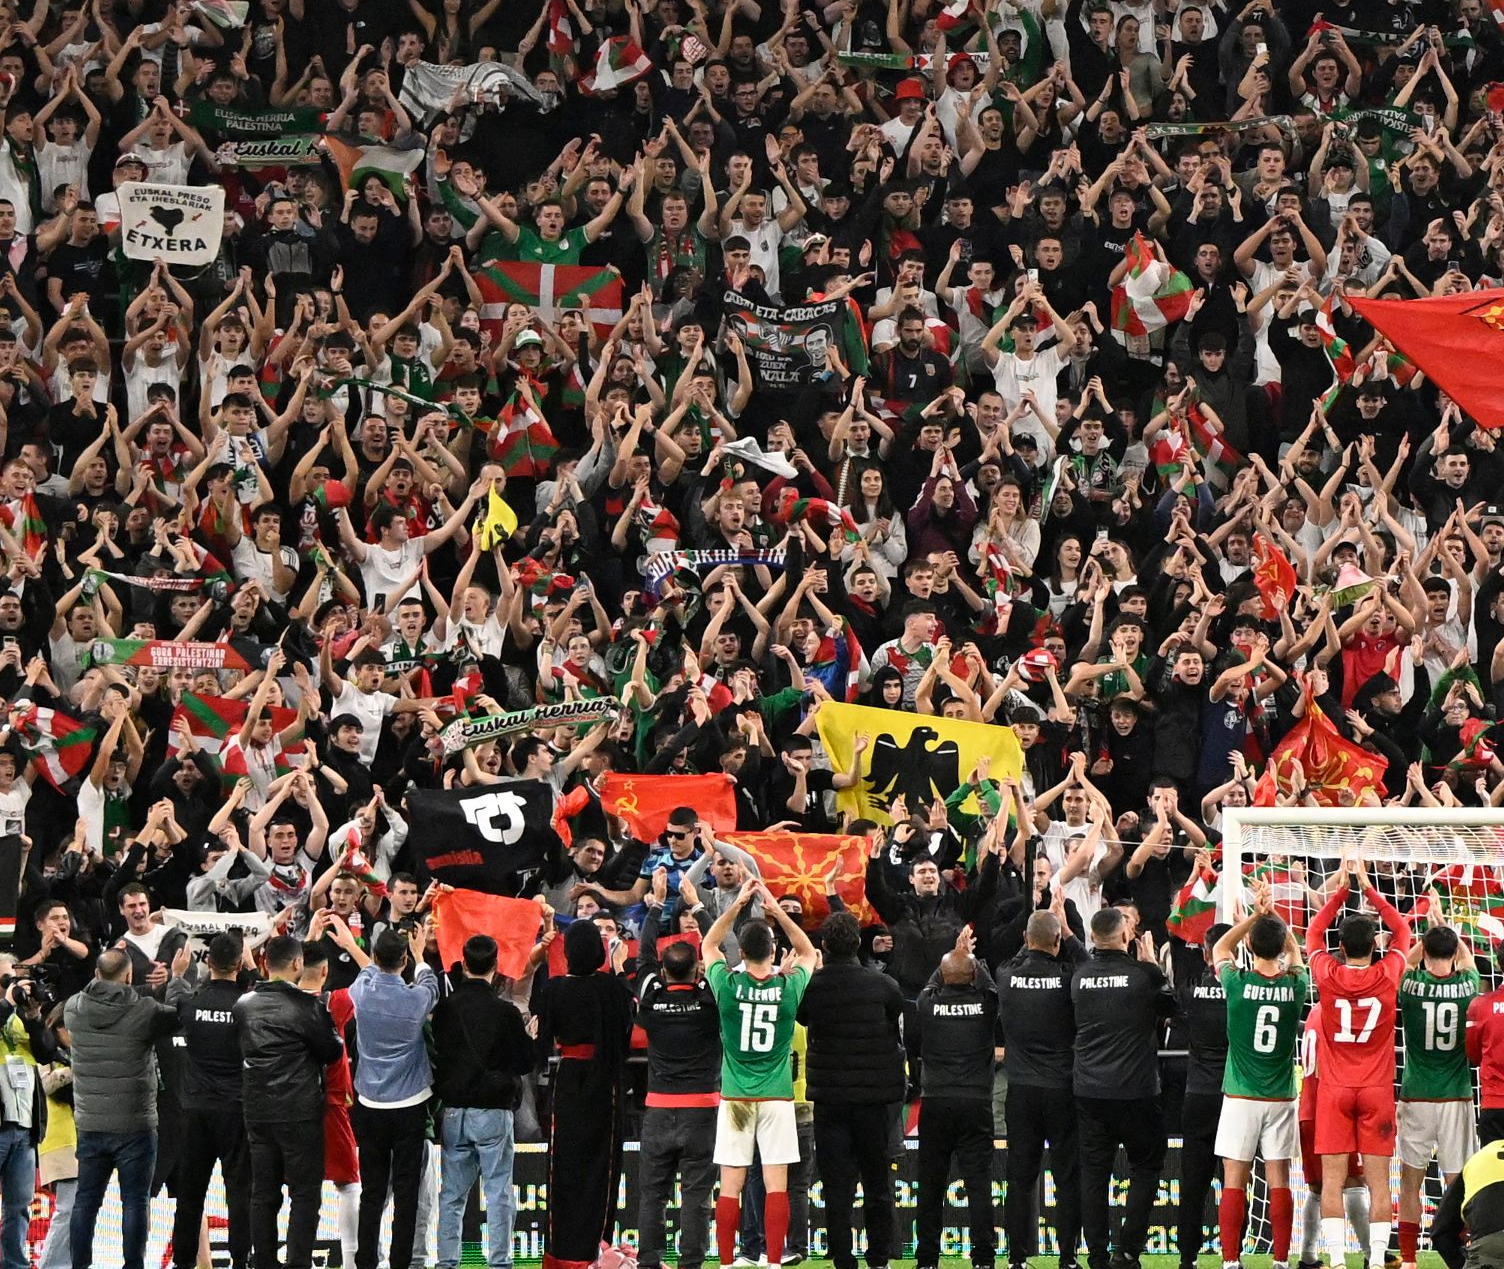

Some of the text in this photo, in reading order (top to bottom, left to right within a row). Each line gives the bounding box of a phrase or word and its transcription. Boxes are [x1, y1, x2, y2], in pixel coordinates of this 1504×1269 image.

[225, 119, 283, 132] PALESTINA
[234, 136, 301, 157] Euskal
[129, 195, 213, 212] ETA IHESLARIAK
[134, 187, 211, 204] EUSKAL PRESO
[125, 228, 207, 252] ETXERA
[908, 373, 918, 389] 7
[150, 646, 226, 660] GORA PALESTINAR
[152, 655, 224, 669] ERRESISTENTZIA!
[461, 711, 530, 738] Euskal
[532, 697, 608, 724] Herria
[1010, 975, 1063, 989] PALESTINE
[1079, 975, 1129, 989] PALESTINE
[1402, 979, 1425, 996] OIER
[748, 986, 782, 1002] LEKUE
[1243, 983, 1295, 1002] GUEVARA
[933, 1002, 984, 1016] PALESTINE
[739, 1002, 779, 1053] 15
[1333, 996, 1382, 1044] 17
[1421, 1001, 1459, 1051] 19
[1253, 1005, 1281, 1054] 6
